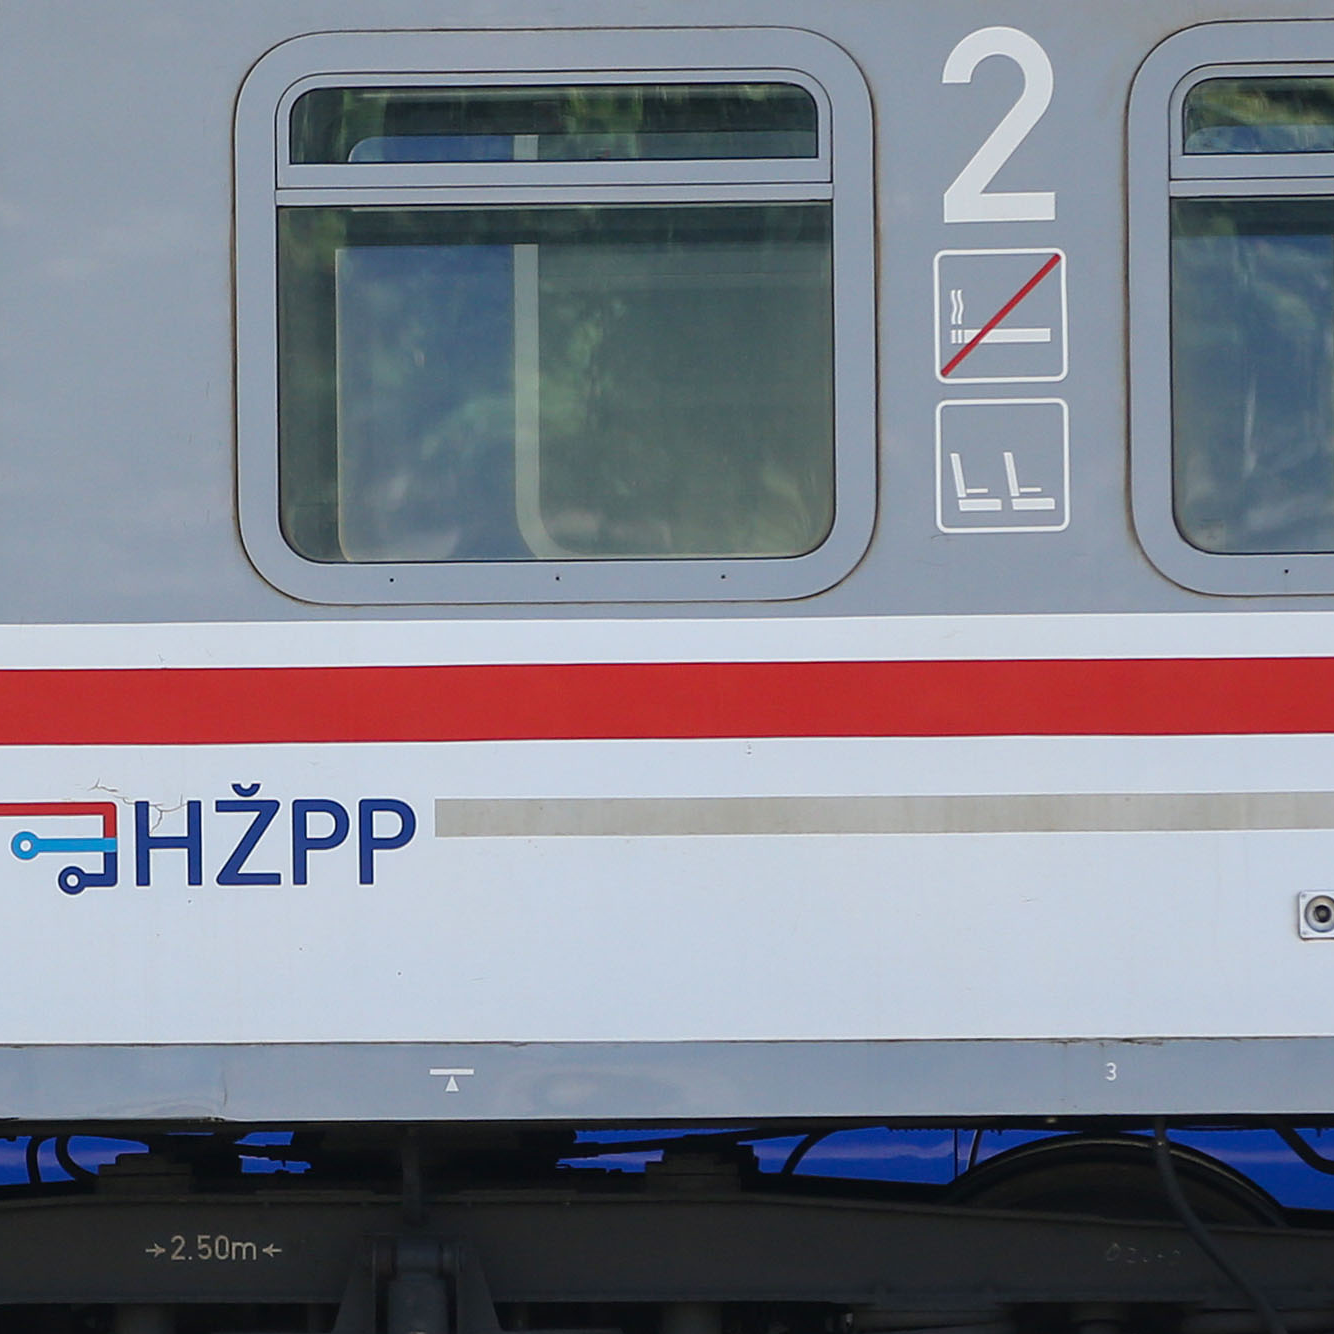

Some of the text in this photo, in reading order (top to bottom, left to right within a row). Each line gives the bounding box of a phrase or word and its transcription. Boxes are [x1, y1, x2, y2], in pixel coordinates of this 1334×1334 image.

[942, 26, 1056, 223] 2
[134, 783, 417, 887] HŽPP
[1106, 1063, 1117, 1081] 3
[170, 1235, 257, 1261] 2.50m
